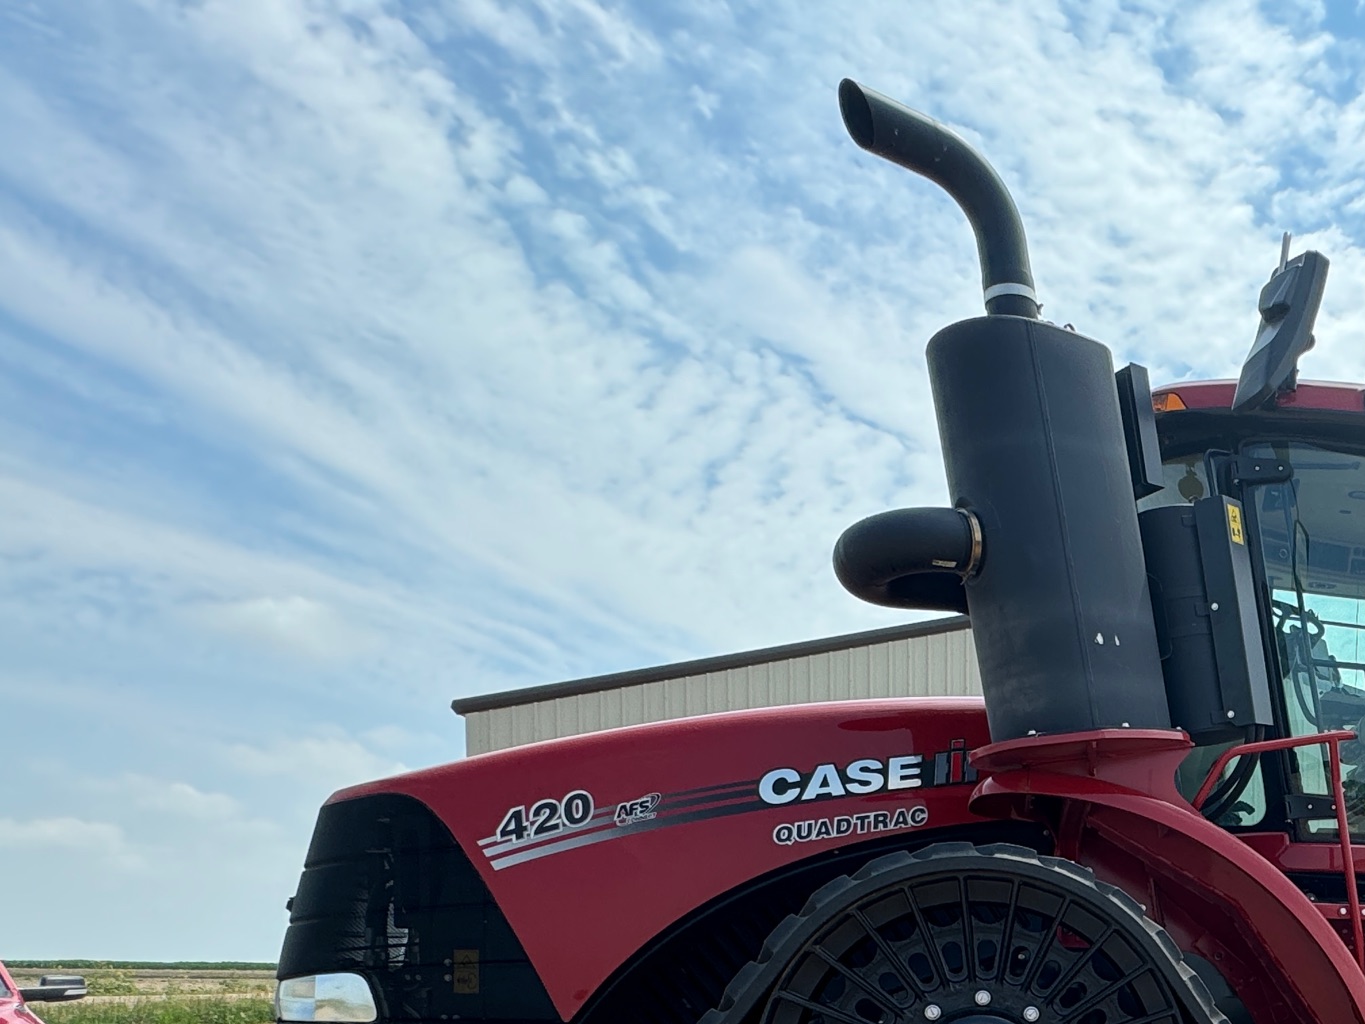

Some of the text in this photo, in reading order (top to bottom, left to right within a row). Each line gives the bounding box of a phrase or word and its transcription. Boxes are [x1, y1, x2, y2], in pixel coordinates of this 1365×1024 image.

[758, 754, 923, 805] CASE
[496, 789, 595, 844] 420
[614, 797, 653, 821] AFS
[773, 805, 929, 845] QUADTRAC
